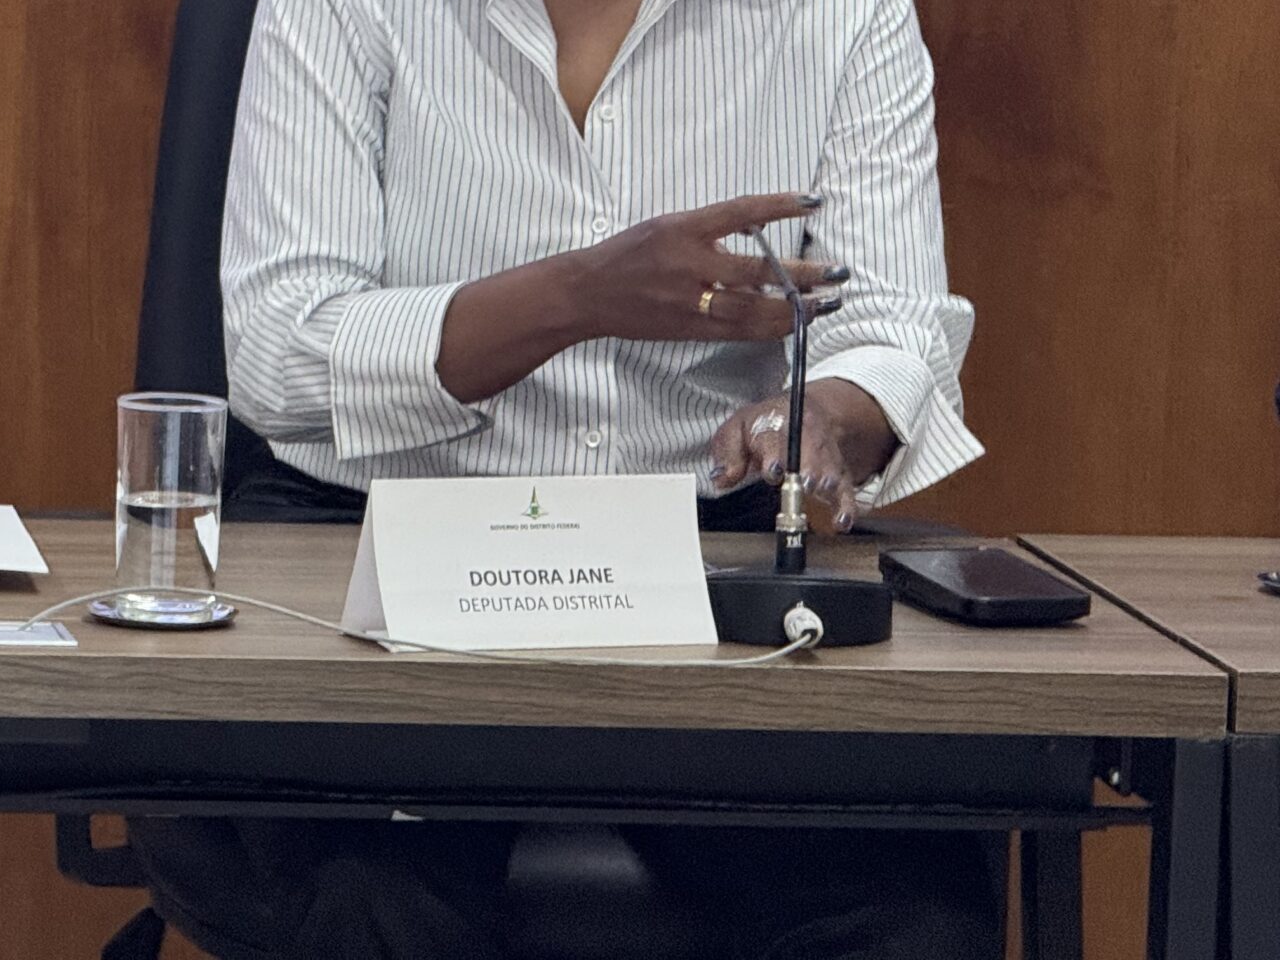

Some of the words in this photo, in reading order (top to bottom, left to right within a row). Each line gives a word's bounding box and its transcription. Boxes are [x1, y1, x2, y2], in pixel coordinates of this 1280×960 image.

[469, 568, 565, 587] DOUTORA
[568, 567, 615, 585] JANE
[458, 596, 550, 614] DEPUTADA
[552, 593, 635, 611] DISTRITAL
